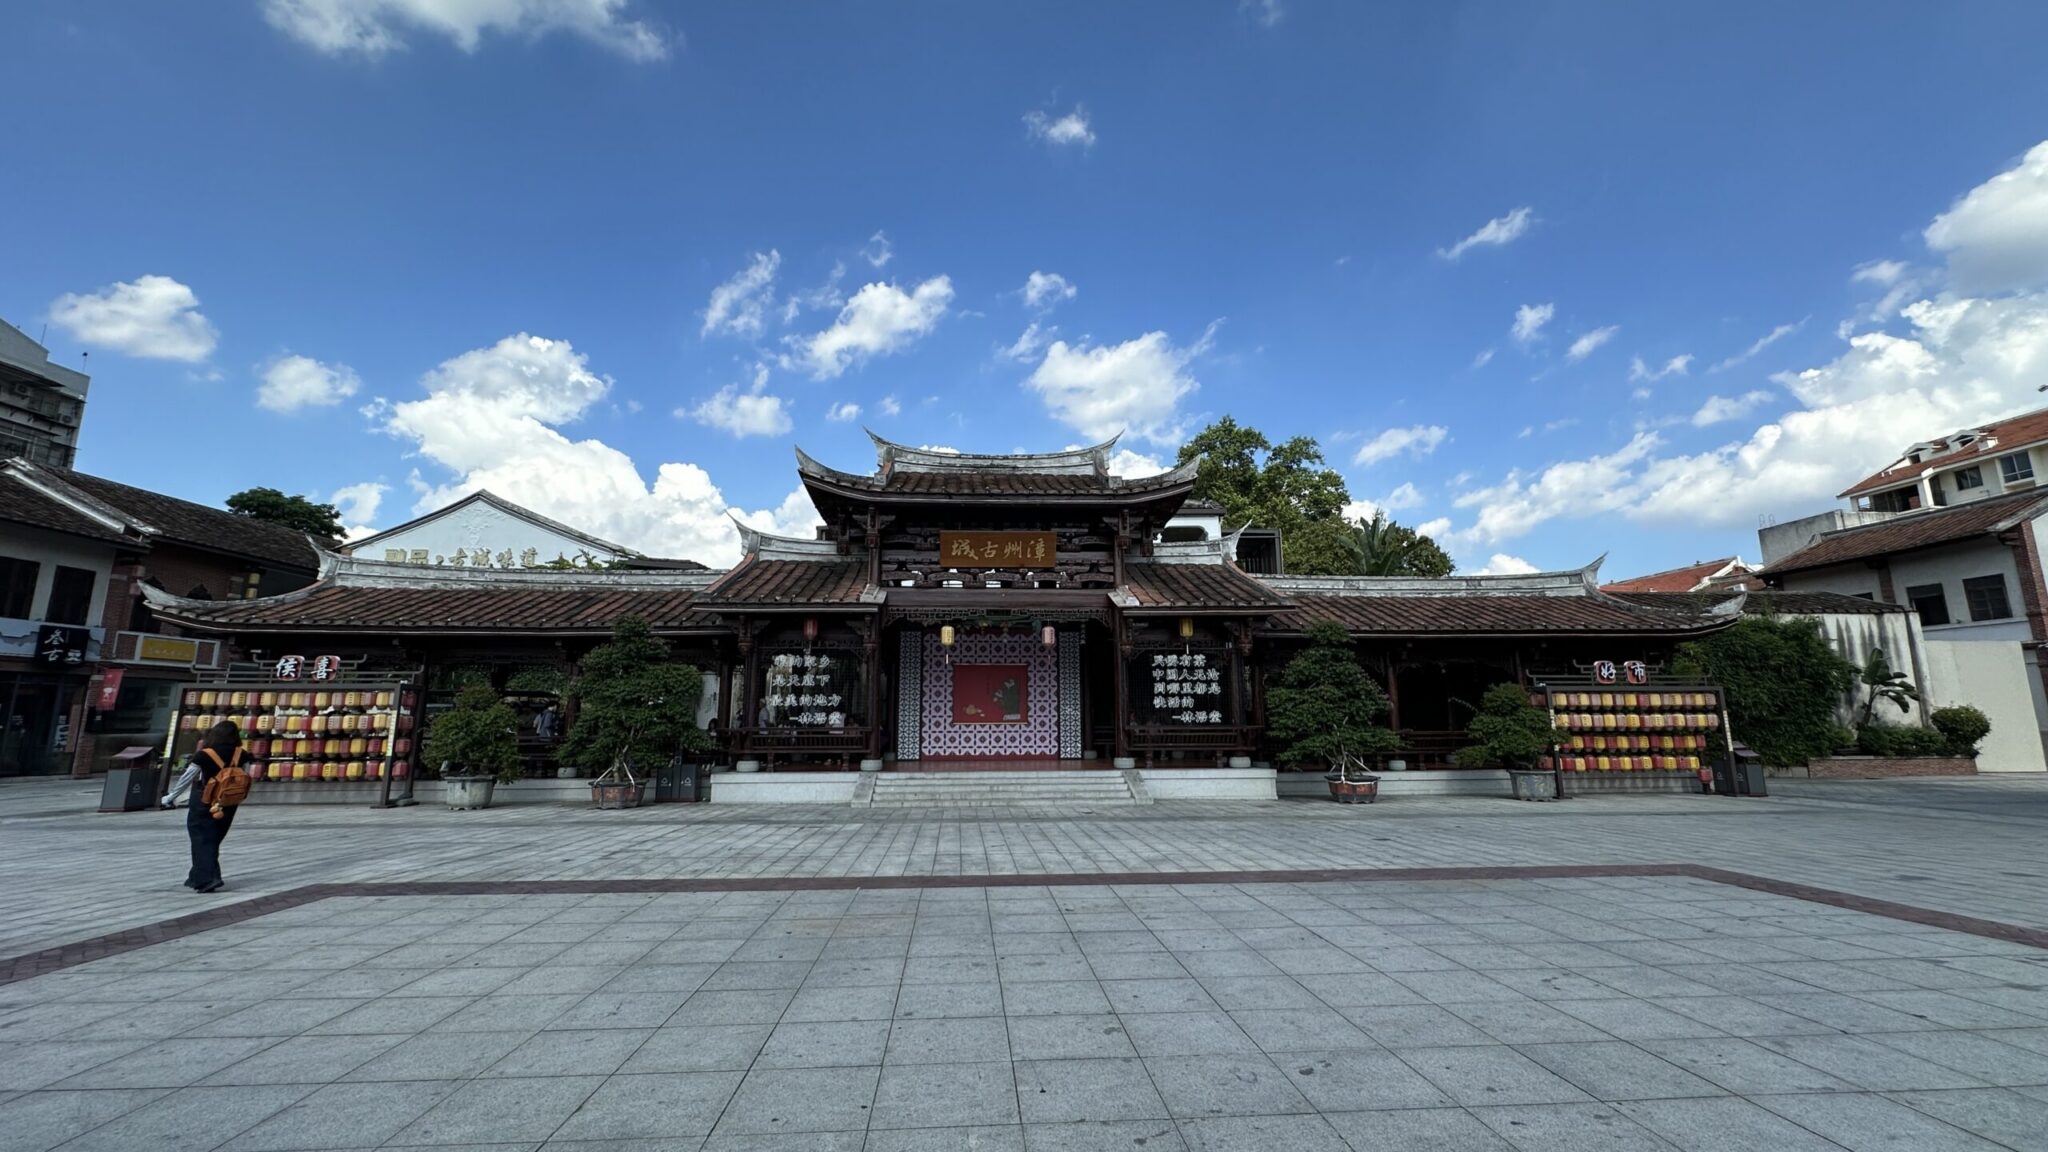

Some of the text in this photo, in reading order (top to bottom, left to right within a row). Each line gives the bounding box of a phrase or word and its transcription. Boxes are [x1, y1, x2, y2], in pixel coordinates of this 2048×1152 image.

[951, 538, 1046, 562] 漳州古城
[773, 674, 831, 687] 是天底下
[1152, 668, 1220, 681] 中国人无论
[1153, 681, 1222, 695] 到哪里都是
[768, 694, 842, 707] 最美的地方
